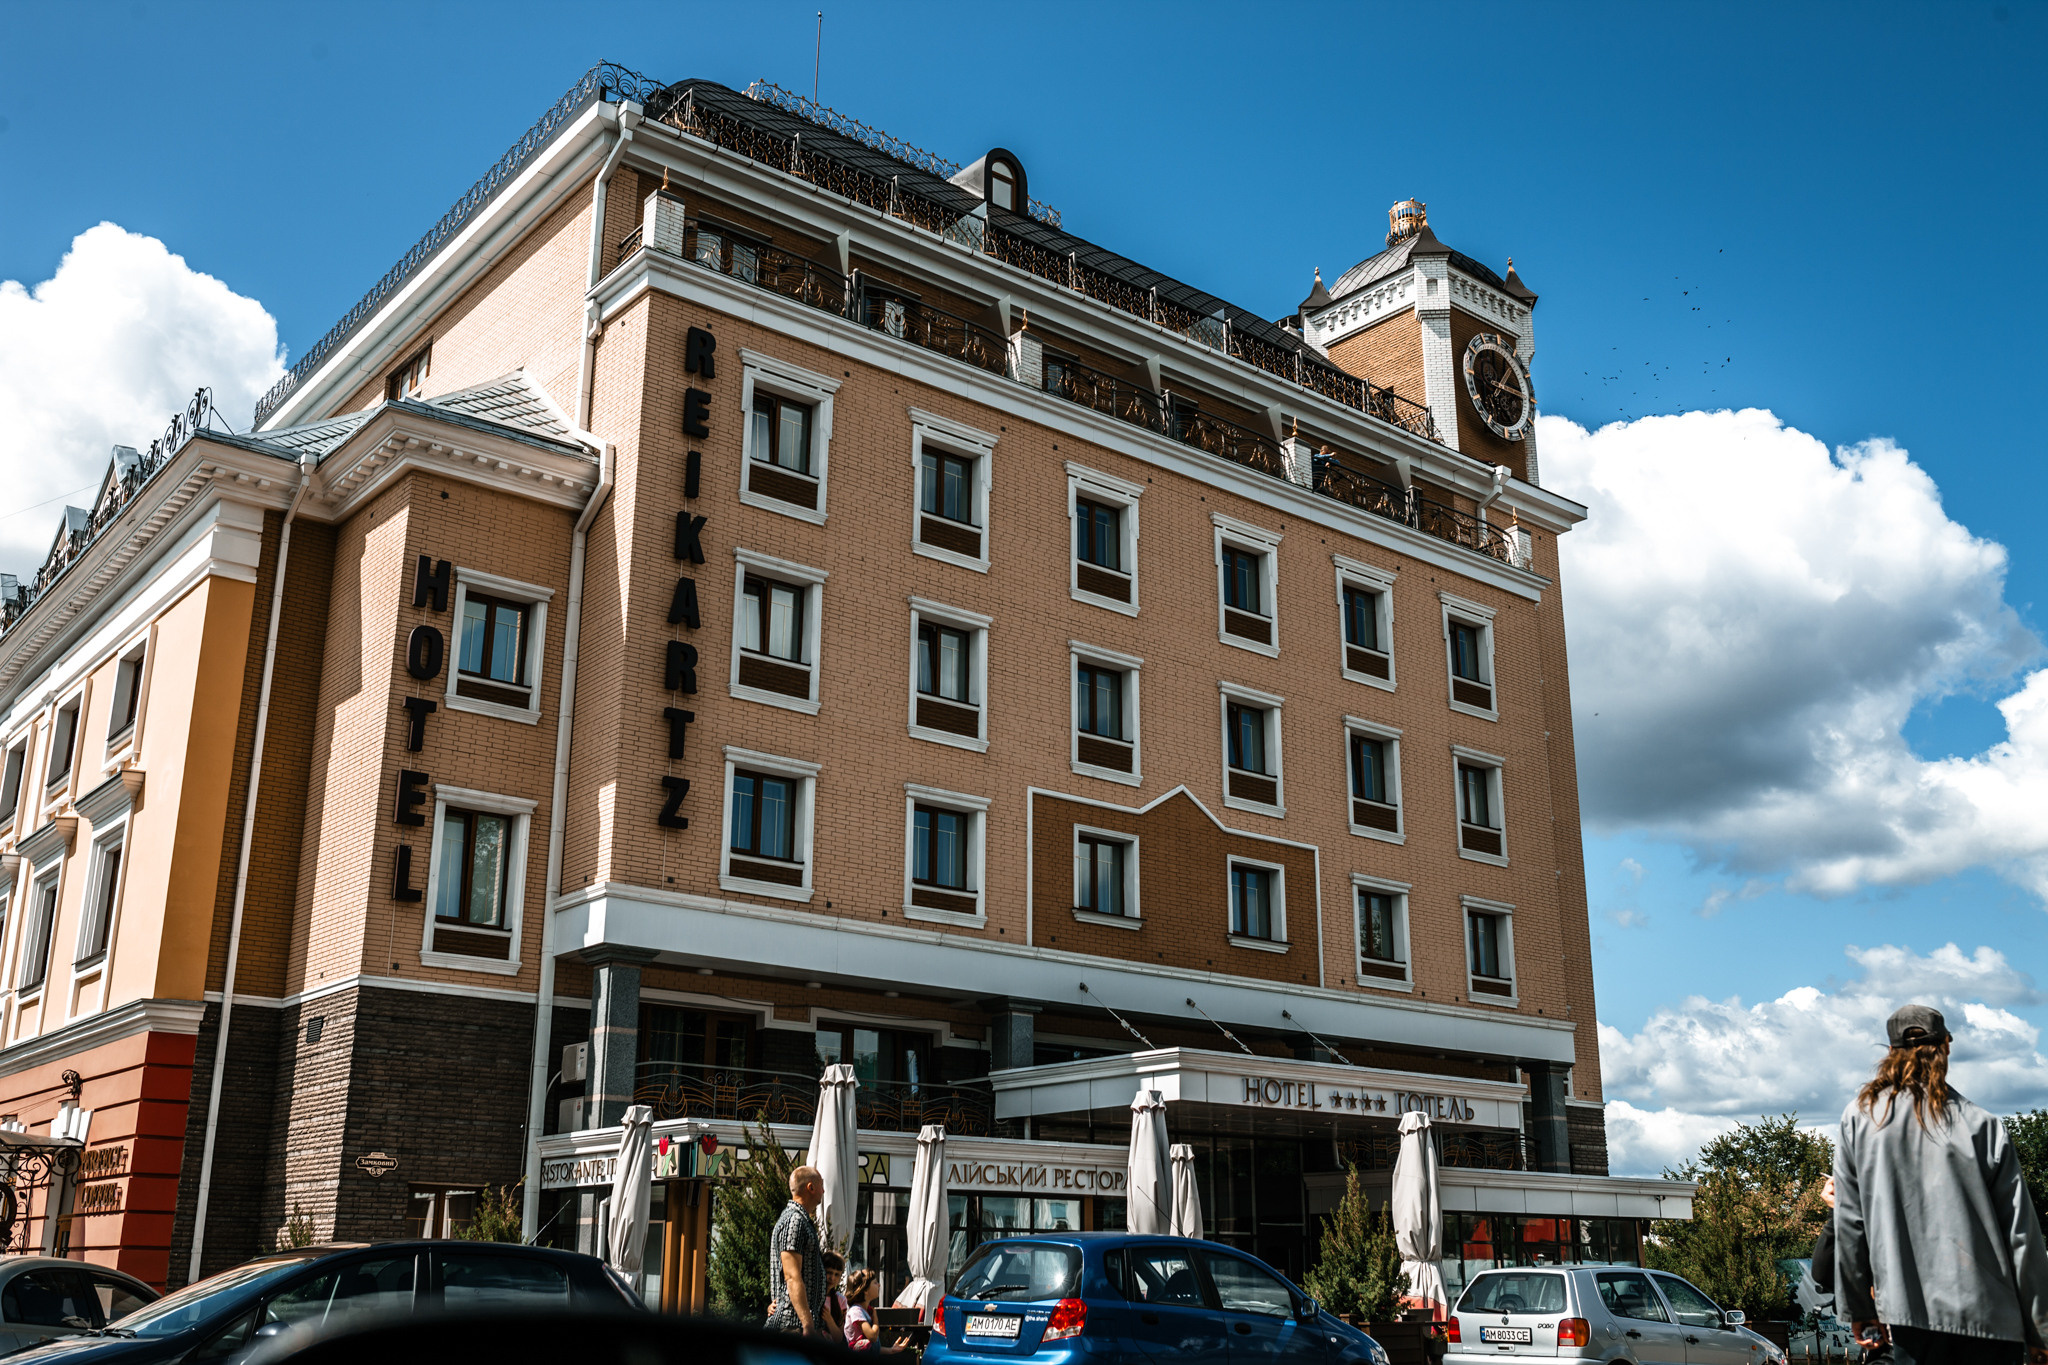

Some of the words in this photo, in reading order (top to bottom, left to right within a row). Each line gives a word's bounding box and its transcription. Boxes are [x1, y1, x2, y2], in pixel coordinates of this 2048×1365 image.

[658, 326, 716, 829] REIKARTZ
[393, 555, 451, 902] HOTEL
[1242, 1077, 1322, 1108] HOTEL
[1395, 1092, 1474, 1121] ГОТЕЛЬ
[541, 1159, 602, 1181] RISTORANTE
[971, 1317, 984, 1329] AM
[985, 1318, 1004, 1330] 0170
[1004, 1319, 1017, 1331] AE
[1485, 1331, 1496, 1340] AM
[1498, 1331, 1516, 1341] 8033
[1516, 1331, 1528, 1341] CE
